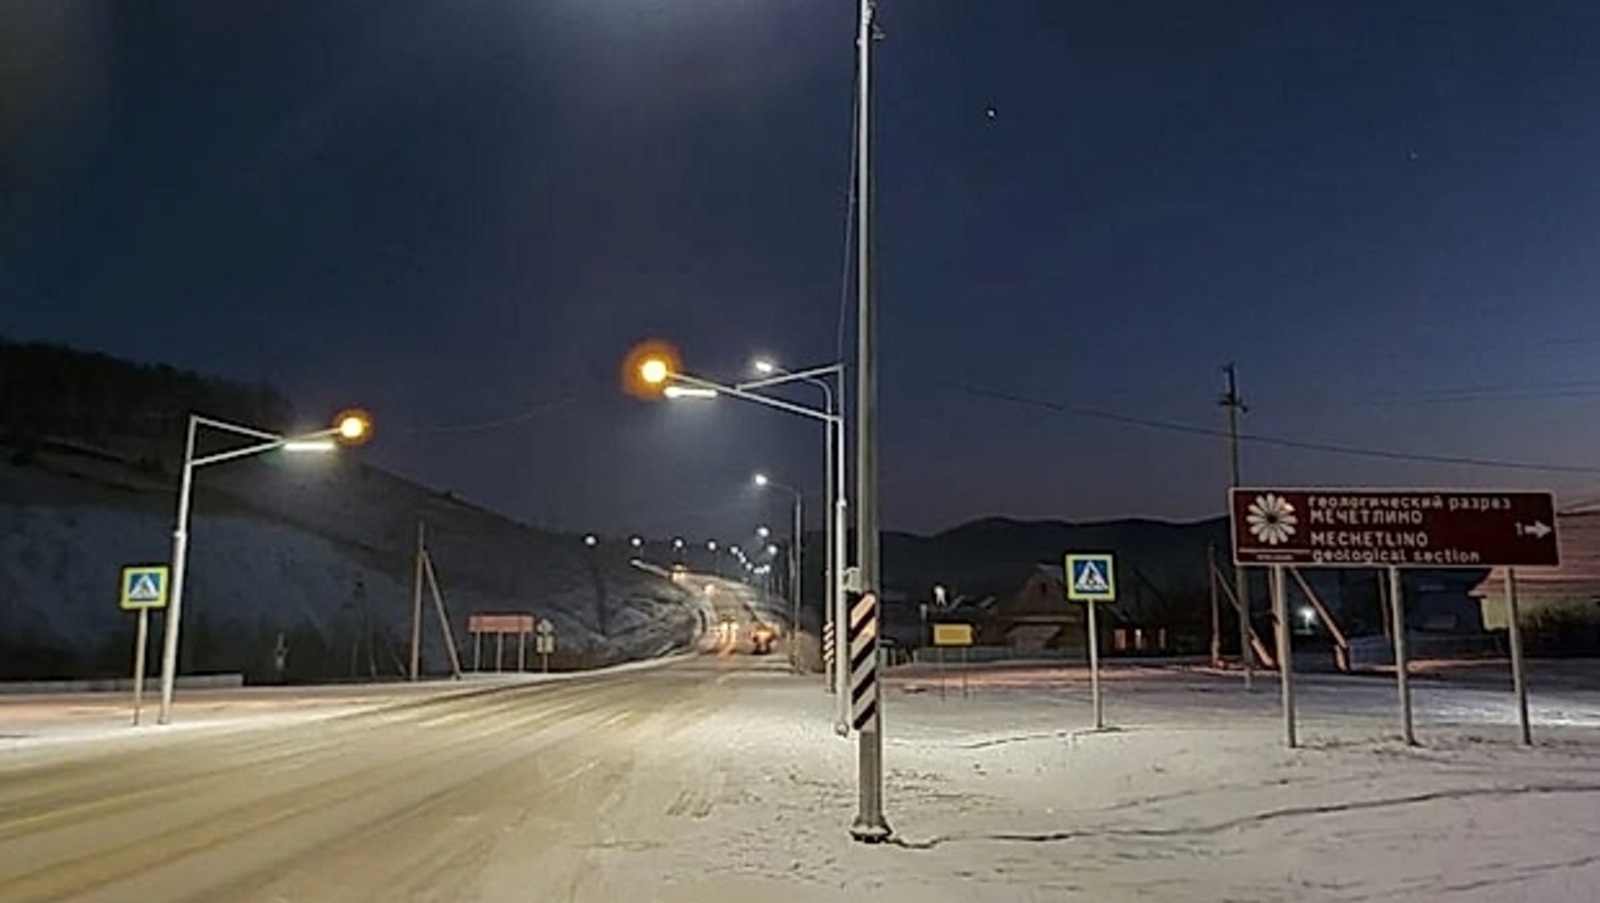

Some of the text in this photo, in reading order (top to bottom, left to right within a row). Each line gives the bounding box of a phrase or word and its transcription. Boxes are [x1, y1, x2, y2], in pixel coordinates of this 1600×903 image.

[1450, 497, 1511, 512] разрез
[1310, 510, 1423, 524] МЕЧЕТЛИНО
[1310, 531, 1428, 546] MECHETLINO
[1313, 549, 1480, 564] geological section
